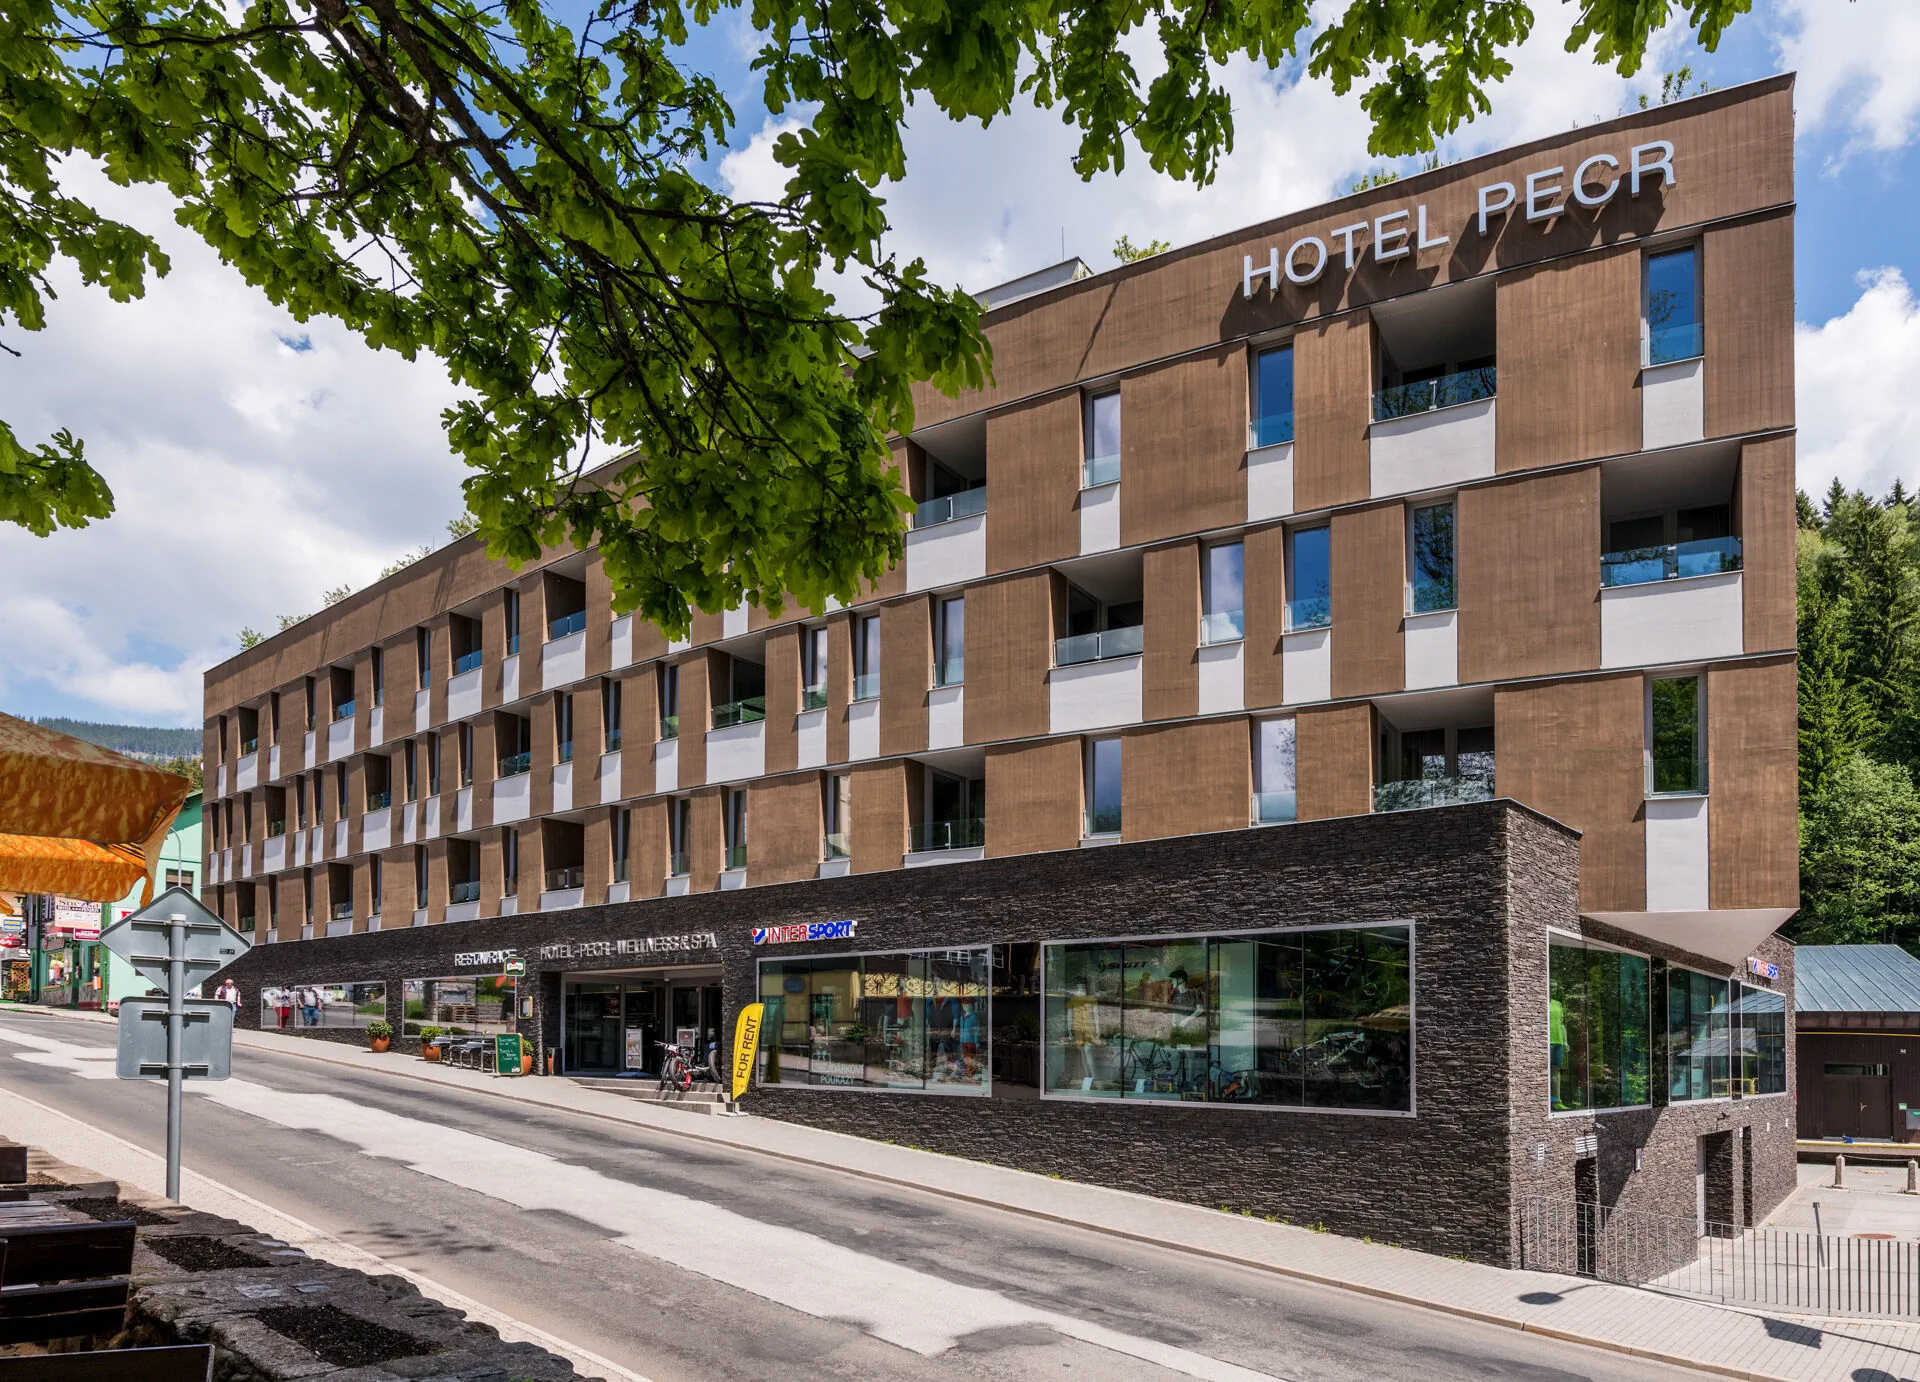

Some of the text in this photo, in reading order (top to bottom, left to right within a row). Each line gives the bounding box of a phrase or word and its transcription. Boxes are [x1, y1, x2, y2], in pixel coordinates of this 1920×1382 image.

[1243, 140, 1676, 299] HOTEL PECR
[540, 943, 575, 960] HOTEL
[691, 932, 718, 950] SPA
[767, 920, 854, 944] INTERSPORT
[736, 1015, 758, 1079] FOR RENT
